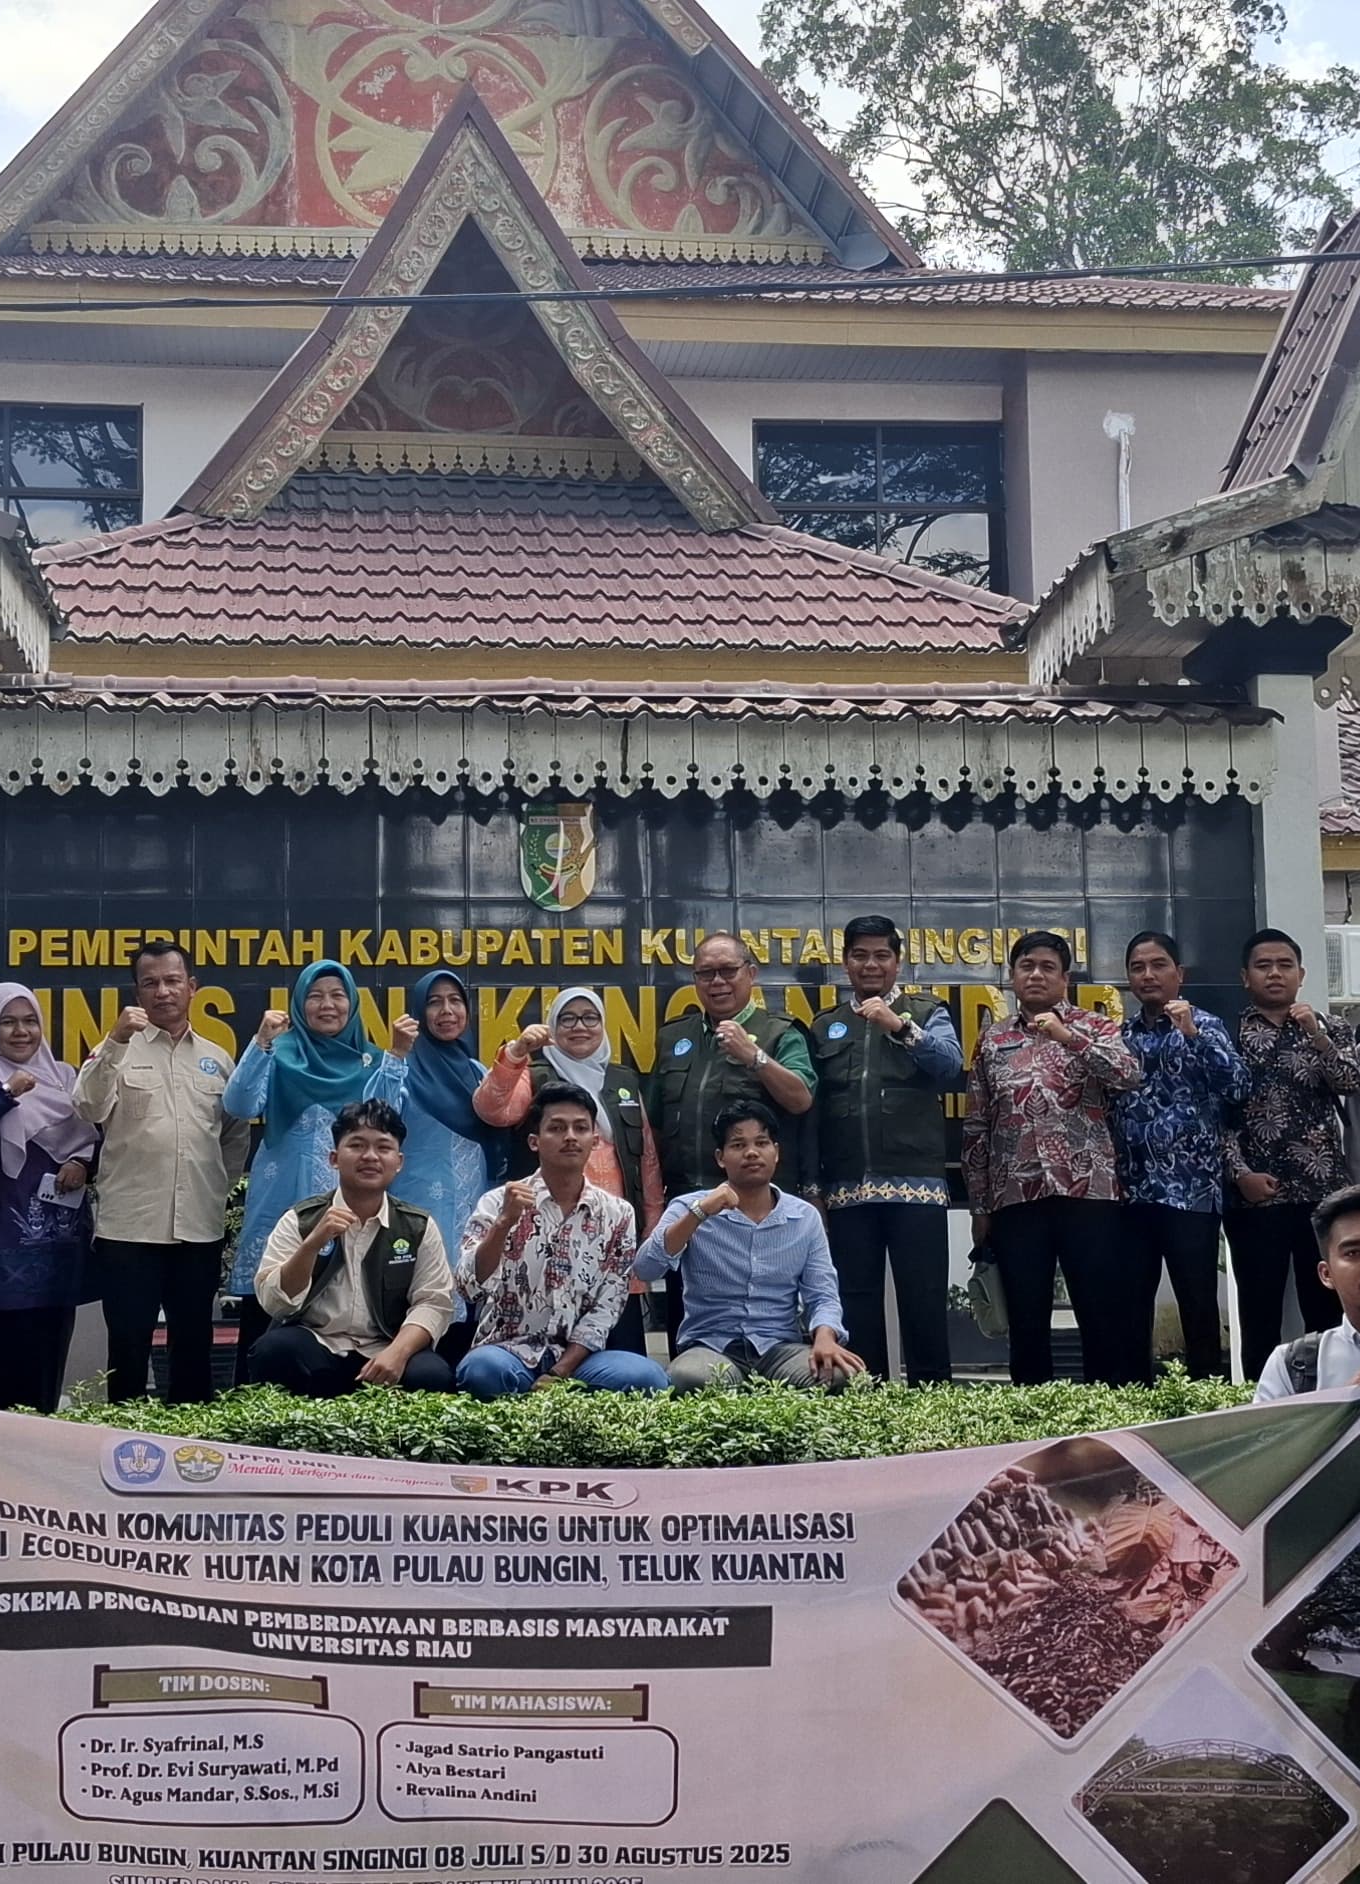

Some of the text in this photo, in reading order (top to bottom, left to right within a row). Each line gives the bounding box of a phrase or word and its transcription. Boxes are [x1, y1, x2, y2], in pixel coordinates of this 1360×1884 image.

[340, 929, 623, 966] KABUPATEN
[641, 928, 844, 965] KUNTA
[227, 1453, 280, 1464] LPPM
[496, 1478, 616, 1500] KPK
[118, 1512, 285, 1541] KOMUNITAS
[296, 1514, 392, 1542] PEDULI
[403, 1514, 548, 1542] KUANSING
[557, 1515, 651, 1542] UNTUK
[661, 1512, 856, 1542] OPTIMALISASI
[21, 1532, 191, 1577] ECOEDUPARK
[204, 1554, 300, 1583] HUTAN
[311, 1554, 382, 1583] KOTA
[393, 1554, 484, 1583] PULAU
[494, 1554, 608, 1587] BUNGIN,
[618, 1554, 701, 1581] TELUK
[711, 1552, 846, 1580] KUANTAN
[88, 1590, 238, 1625] PENGABDIAN
[244, 1610, 436, 1635] PEMBERDAYAAN
[442, 1618, 559, 1637] BERBASIS
[565, 1617, 729, 1637] MASYARAKAT
[252, 1631, 472, 1658] UNIVERSITAS RIAU
[159, 1675, 270, 1693] TIM DOSEN:
[451, 1694, 612, 1711] TIM MAHASISWA:
[90, 1734, 264, 1757] Dr. Ir. Syafrinal, M.S
[405, 1741, 604, 1764] Jagad Satrio Pangastuti
[90, 1757, 339, 1781] Prof. Dr. Evi Suryawati, M.Pd
[405, 1762, 506, 1779] Alya Bestari
[91, 1782, 340, 1806] Dr. Agus Mandar, S.Sos., M.Si
[405, 1783, 538, 1803] Revalina Andini
[12, 1843, 91, 1863] PULAU
[97, 1844, 193, 1869] BUNGIN,
[199, 1849, 316, 1870] KUANTAN
[323, 1848, 428, 1871] SINGINGI
[434, 1847, 465, 1868] 08
[471, 1845, 524, 1866] JULI
[530, 1844, 571, 1865] S/D
[578, 1844, 608, 1865] 30
[615, 1845, 723, 1865] AGUSTUS
[729, 1843, 791, 1865] 2025
